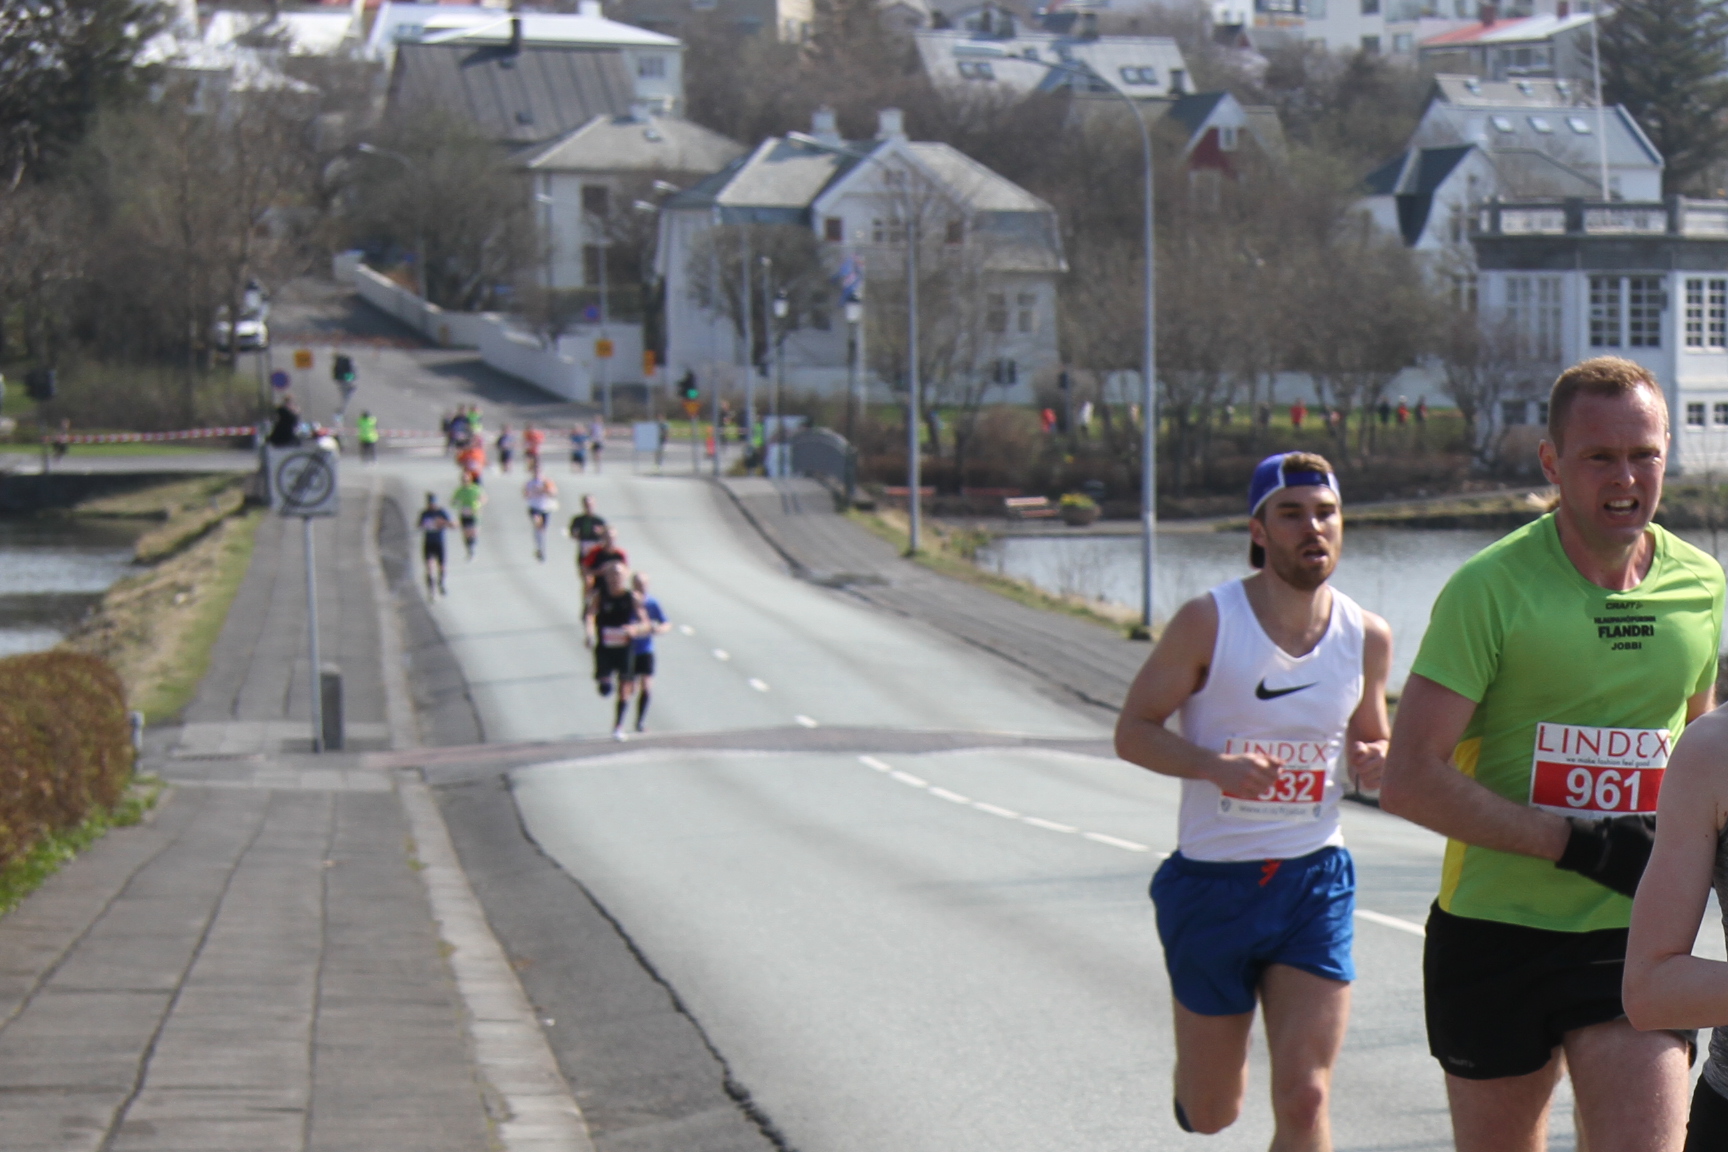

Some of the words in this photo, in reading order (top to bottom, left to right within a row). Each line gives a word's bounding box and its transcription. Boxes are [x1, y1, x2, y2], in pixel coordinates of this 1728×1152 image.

[1598, 625, 1655, 638] FLANDRI
[1538, 725, 1670, 758] LINDEX
[1565, 767, 1641, 810] 961
